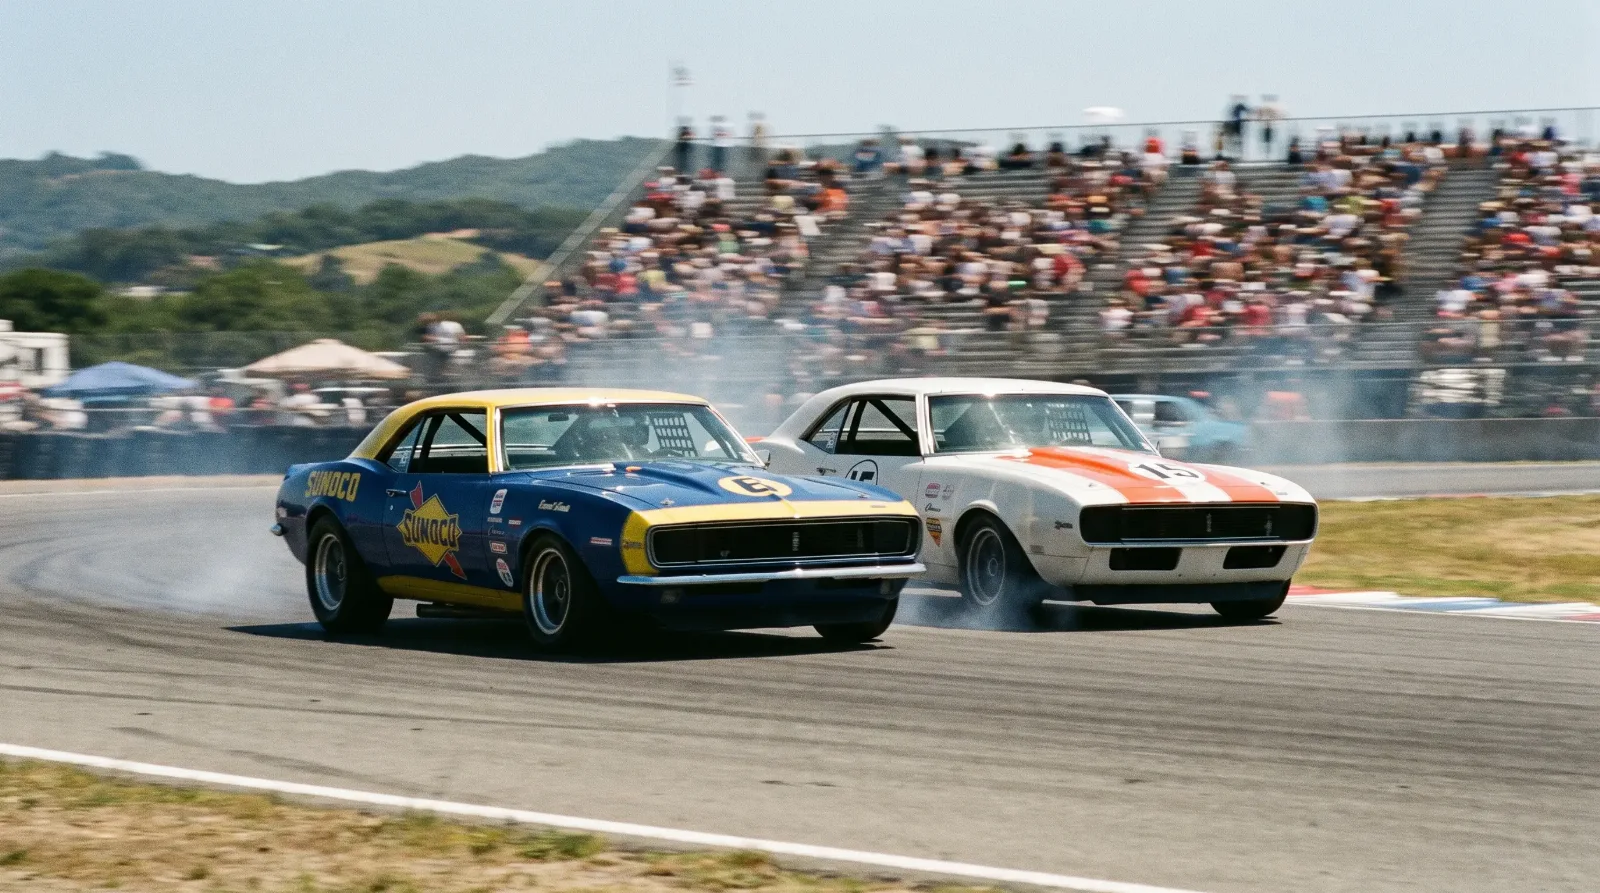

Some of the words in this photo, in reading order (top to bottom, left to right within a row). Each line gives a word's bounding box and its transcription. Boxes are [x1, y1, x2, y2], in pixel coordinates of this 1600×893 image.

[305, 471, 361, 502] SUNOCO
[1135, 463, 1199, 479] 15
[404, 512, 457, 547] SUNOCO
